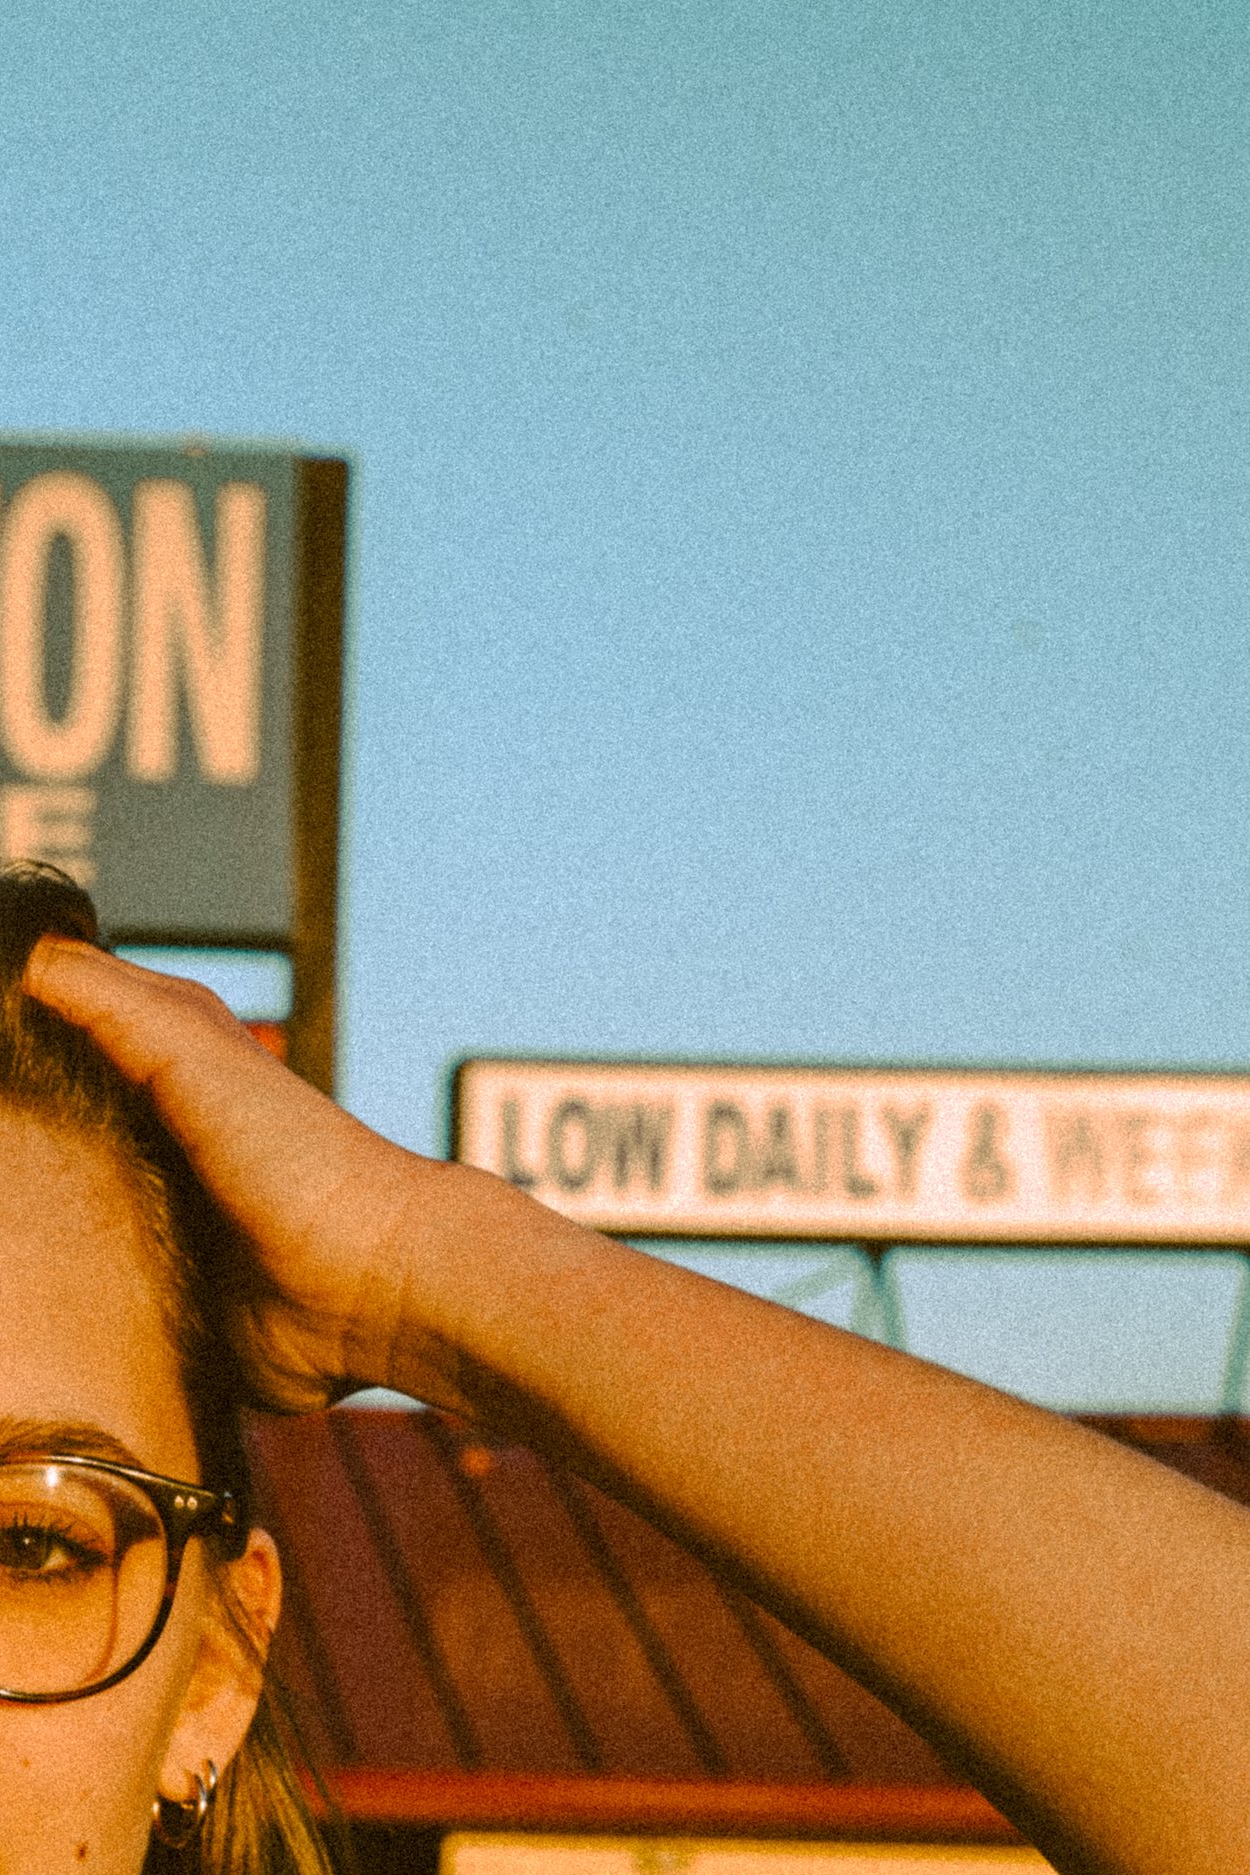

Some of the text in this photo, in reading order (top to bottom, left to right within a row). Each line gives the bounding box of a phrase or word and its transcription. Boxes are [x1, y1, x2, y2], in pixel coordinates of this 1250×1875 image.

[497, 1094, 676, 1193] LOW
[702, 1097, 932, 1202] DAILY
[960, 1099, 1018, 1205] &
